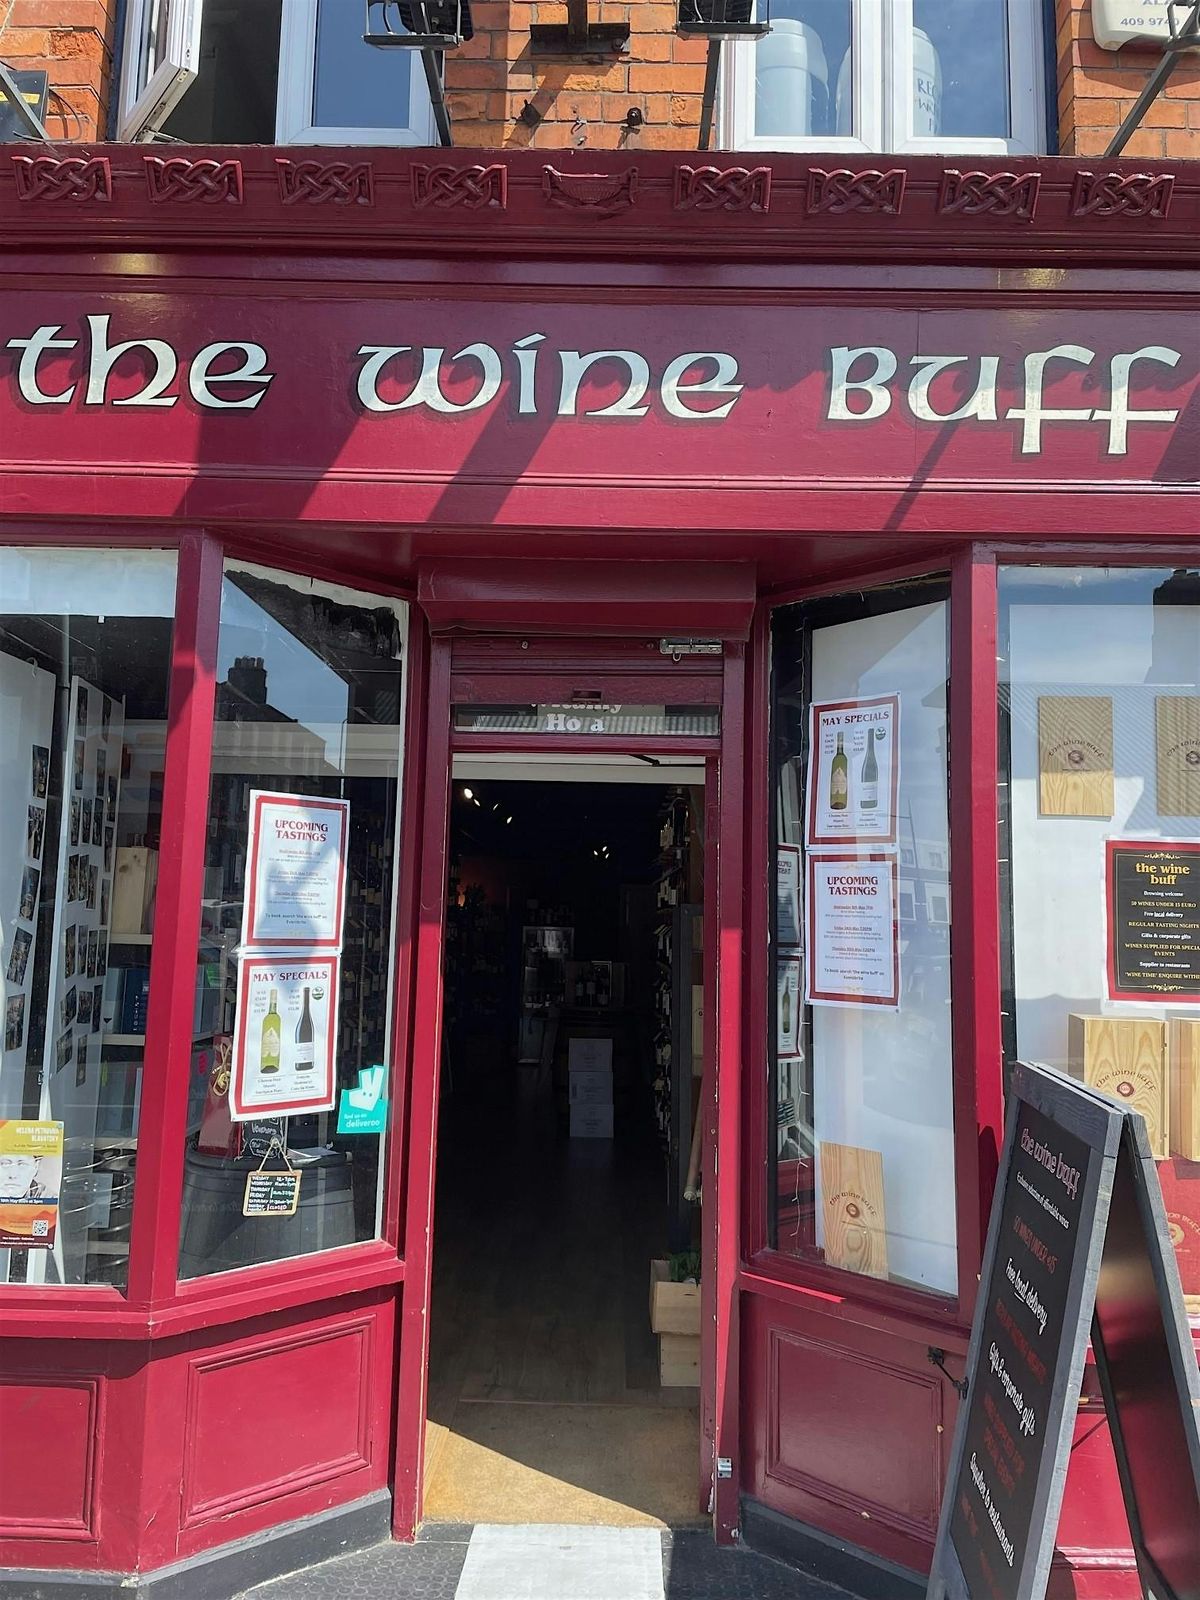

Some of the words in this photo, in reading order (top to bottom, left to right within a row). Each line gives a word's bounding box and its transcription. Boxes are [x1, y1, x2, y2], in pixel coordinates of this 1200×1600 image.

[1120, 17, 1144, 26] 409
[6, 314, 276, 409] the
[822, 717, 842, 726] MAY
[844, 711, 890, 724] SPECIALS
[275, 819, 328, 832] UPCOMING
[276, 830, 326, 842] TASTINGS
[1136, 862, 1157, 874] the
[1160, 864, 1190, 875] wine
[827, 876, 878, 886] UPCOMING
[1150, 874, 1177, 885] buff
[828, 886, 877, 896] TASTINGS
[253, 972, 276, 982] MAY
[279, 970, 328, 981] SPECIALS
[346, 1119, 380, 1128] deliveroo
[1020, 1128, 1034, 1156] the
[1056, 1152, 1081, 1200] buff
[1005, 1257, 1015, 1285] Free
[1025, 1287, 1048, 1336] delivery
